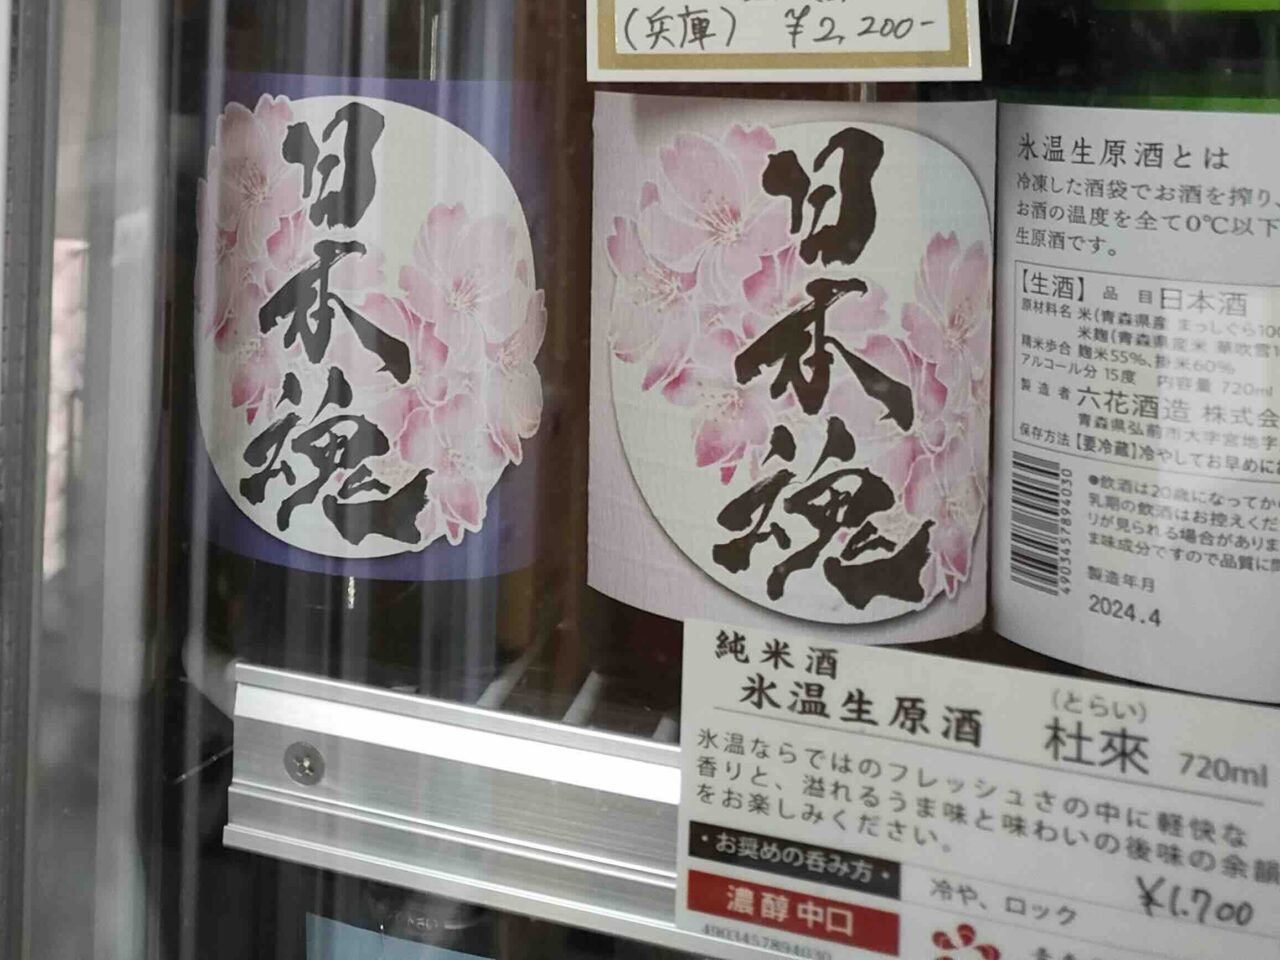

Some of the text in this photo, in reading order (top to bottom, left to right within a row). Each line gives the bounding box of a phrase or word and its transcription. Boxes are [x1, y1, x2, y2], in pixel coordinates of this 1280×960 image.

[1017, 132, 1230, 170] 氷温生原酒とは
[1016, 226, 1117, 257] 生原酒です。
[1022, 269, 1084, 302] 【生酒】
[1161, 288, 1247, 317] 日本酒
[1022, 298, 1072, 319] 原材料名
[240, 101, 434, 545] 日本魂
[713, 126, 936, 610] 日本魂
[1022, 353, 1098, 379] アルコール分
[1105, 367, 1136, 385] 15度
[1020, 422, 1071, 447] 保存方法
[1088, 566, 1155, 592] 製造年月
[1089, 595, 1161, 627] 2024.4
[715, 629, 840, 680] 純米酒
[739, 672, 982, 748] 氷温生原酒
[1052, 689, 1148, 724] (とらい)
[1179, 751, 1269, 789] 720ml
[696, 783, 952, 854] をお楽しみください。
[727, 884, 854, 937] 濃醇中口
